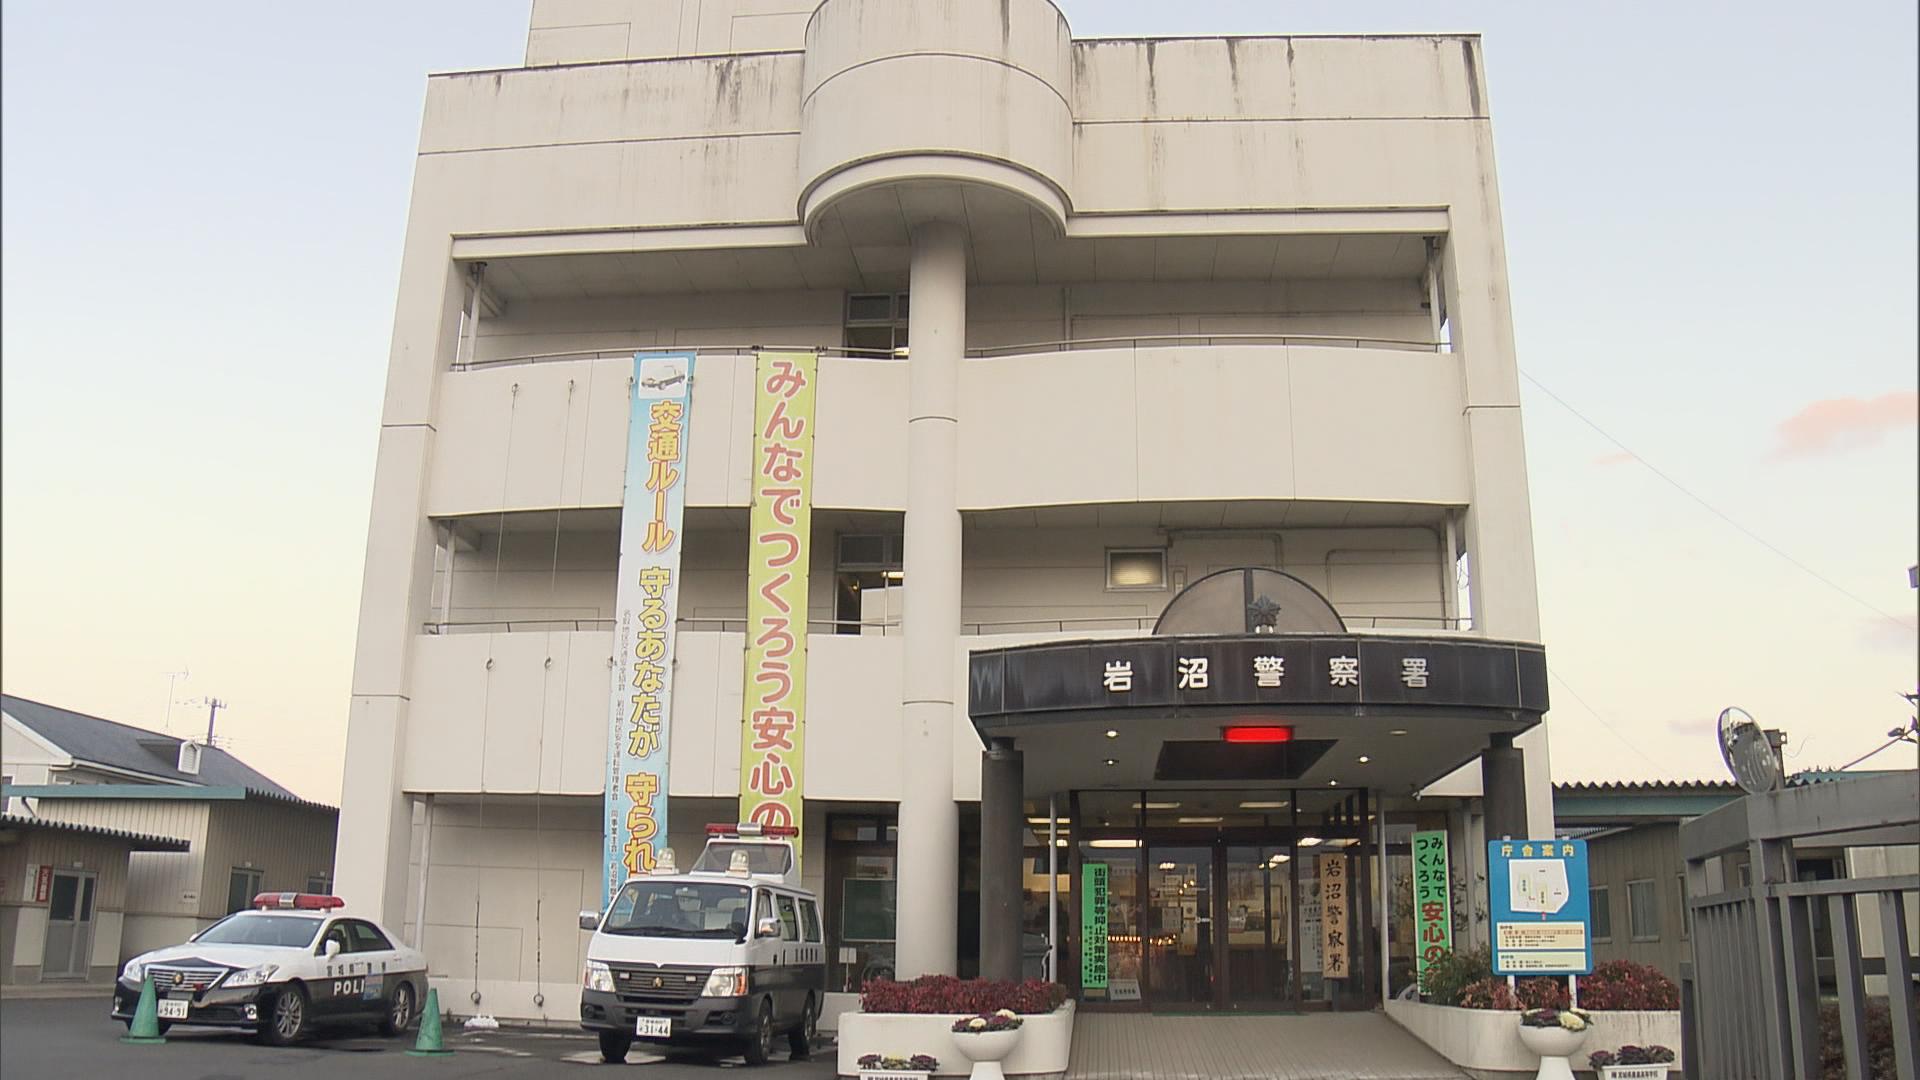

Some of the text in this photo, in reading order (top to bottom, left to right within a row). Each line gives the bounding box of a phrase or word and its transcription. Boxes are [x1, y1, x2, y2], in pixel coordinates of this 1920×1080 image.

[623, 401, 684, 878] 交通ルール 守るあなたが 守られ
[1102, 656, 1431, 692] 岩沼警察署
[1416, 838, 1430, 899] つくろう
[1430, 837, 1446, 898] みんなで
[1501, 843, 1575, 857] 庁舎案内
[1325, 858, 1345, 972] 岩沼警察署
[1421, 900, 1446, 976] 安心の
